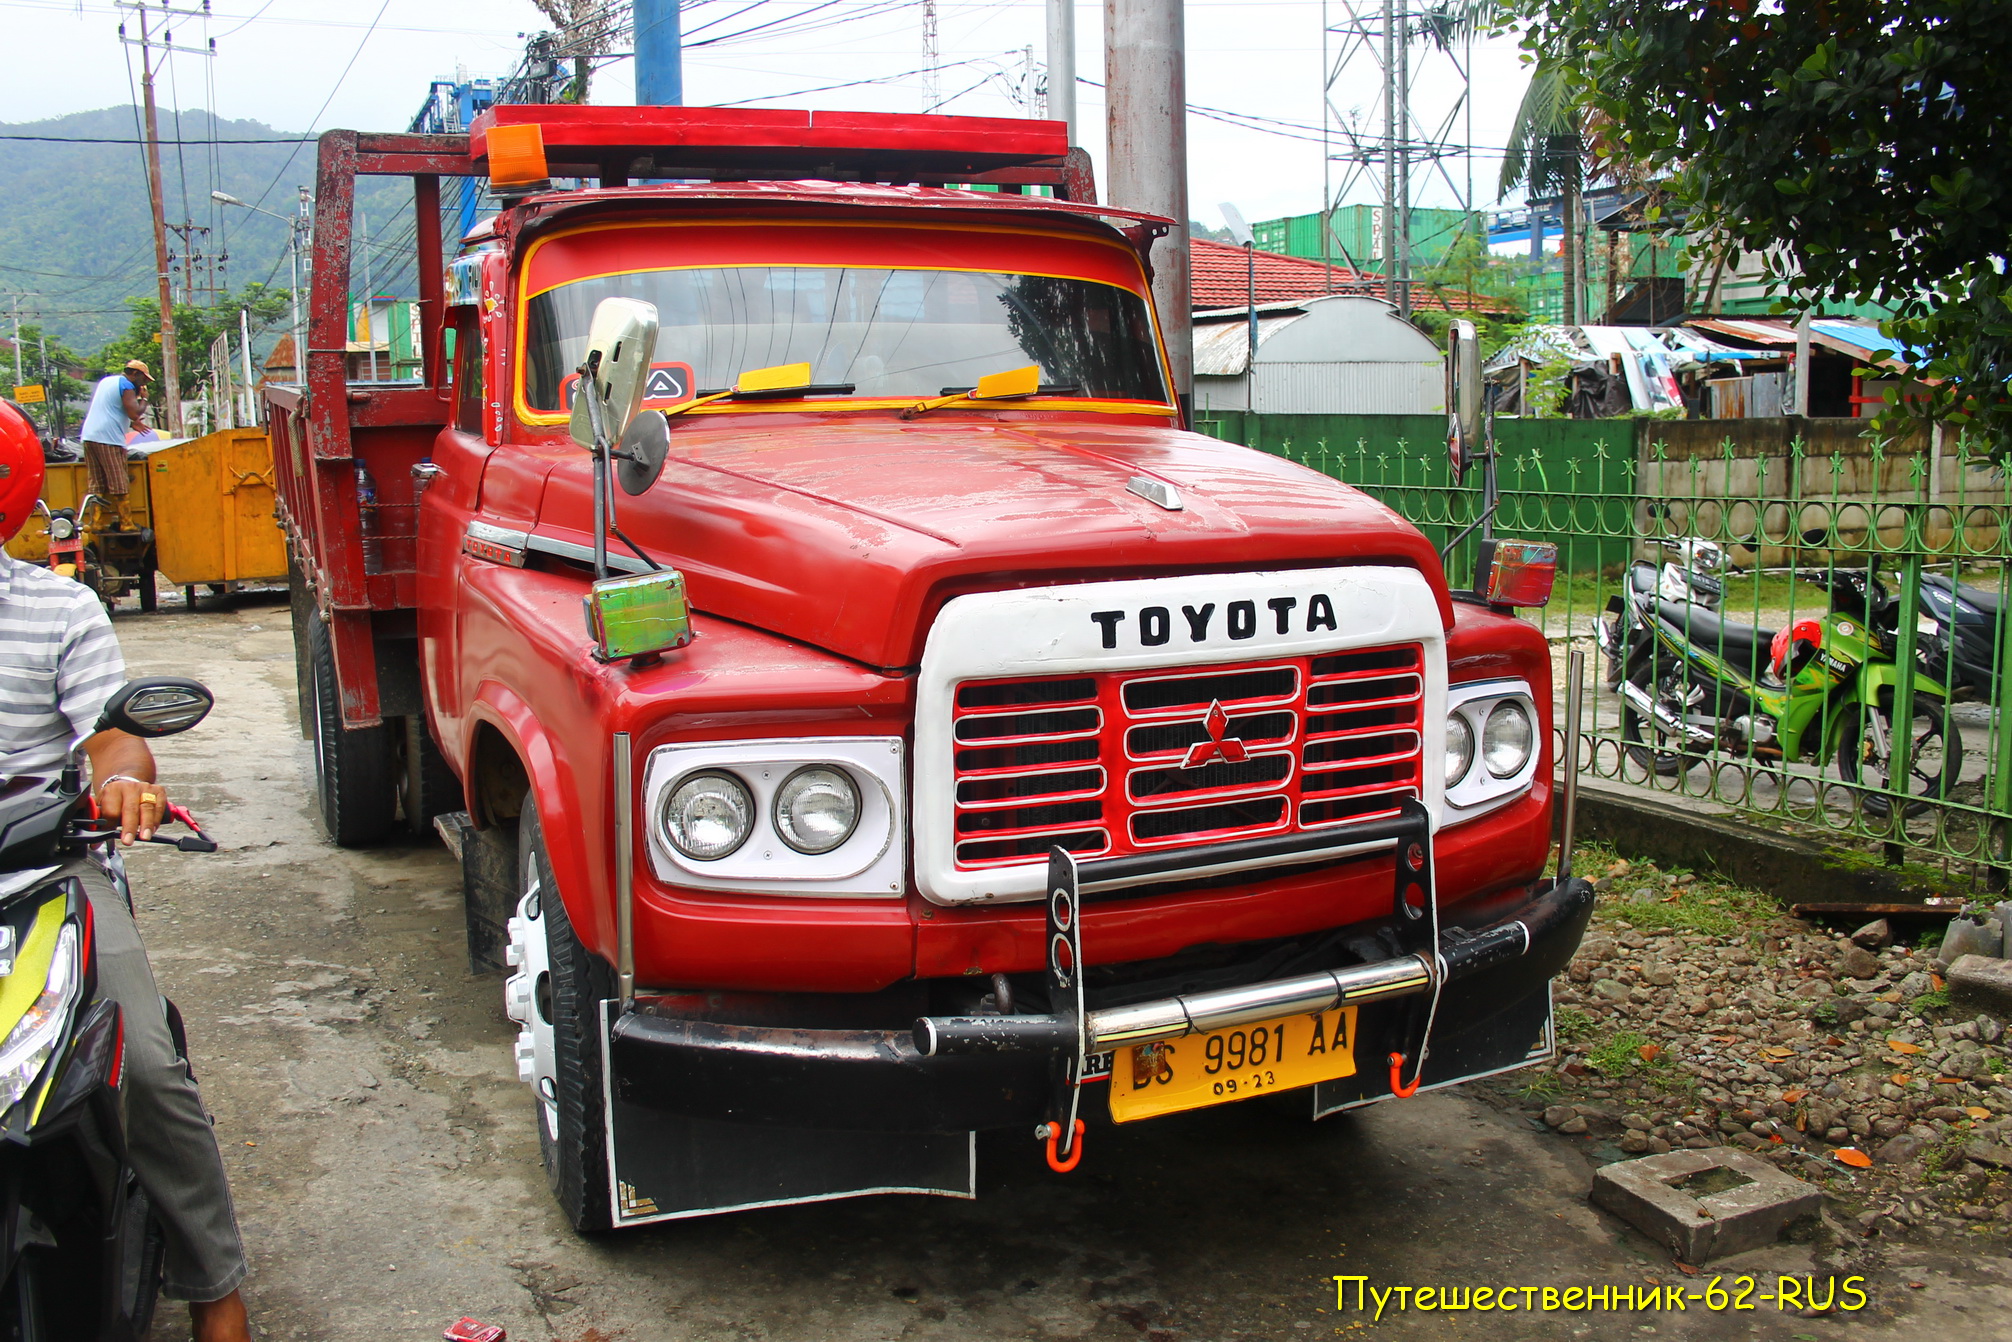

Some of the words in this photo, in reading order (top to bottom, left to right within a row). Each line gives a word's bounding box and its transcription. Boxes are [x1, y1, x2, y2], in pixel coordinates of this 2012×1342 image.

[466, 539, 512, 563] TOYOTA
[1090, 593, 1338, 649] TOYOTA
[1204, 1023, 1285, 1074] 9981
[1307, 1011, 1347, 1056] AA
